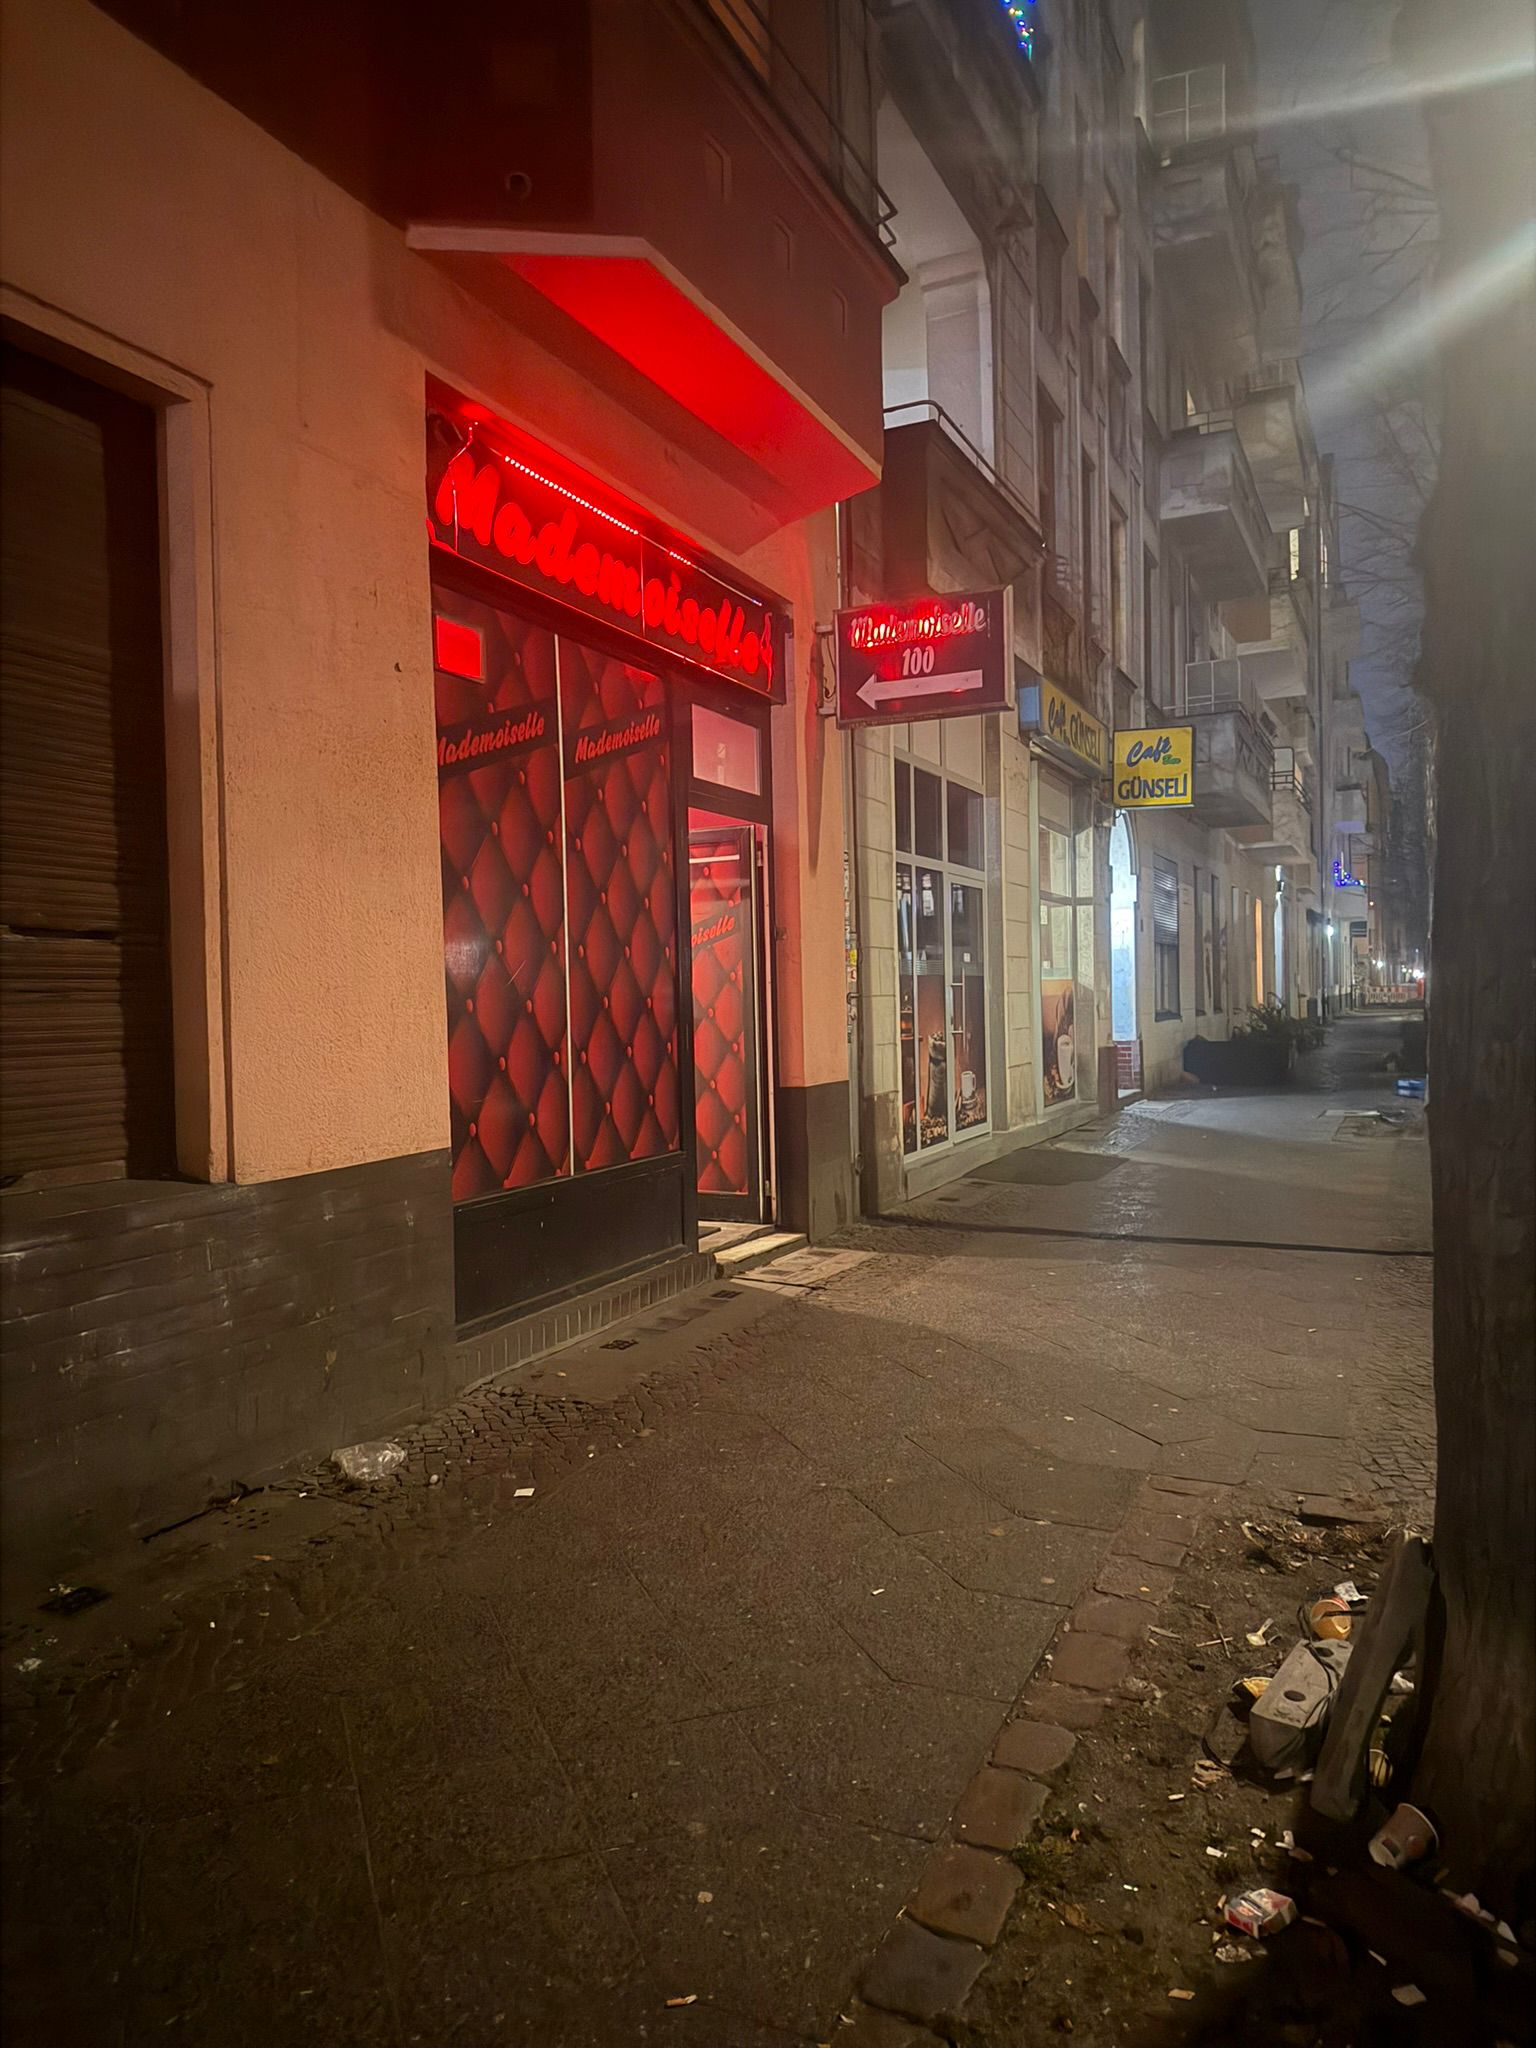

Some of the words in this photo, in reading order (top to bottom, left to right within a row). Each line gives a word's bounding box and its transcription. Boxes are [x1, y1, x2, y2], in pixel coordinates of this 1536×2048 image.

[435, 452, 760, 674] Mademoiselle
[850, 601, 987, 648] Mademoiselle
[903, 645, 935, 676] 100
[575, 714, 660, 763] Mademoiselle
